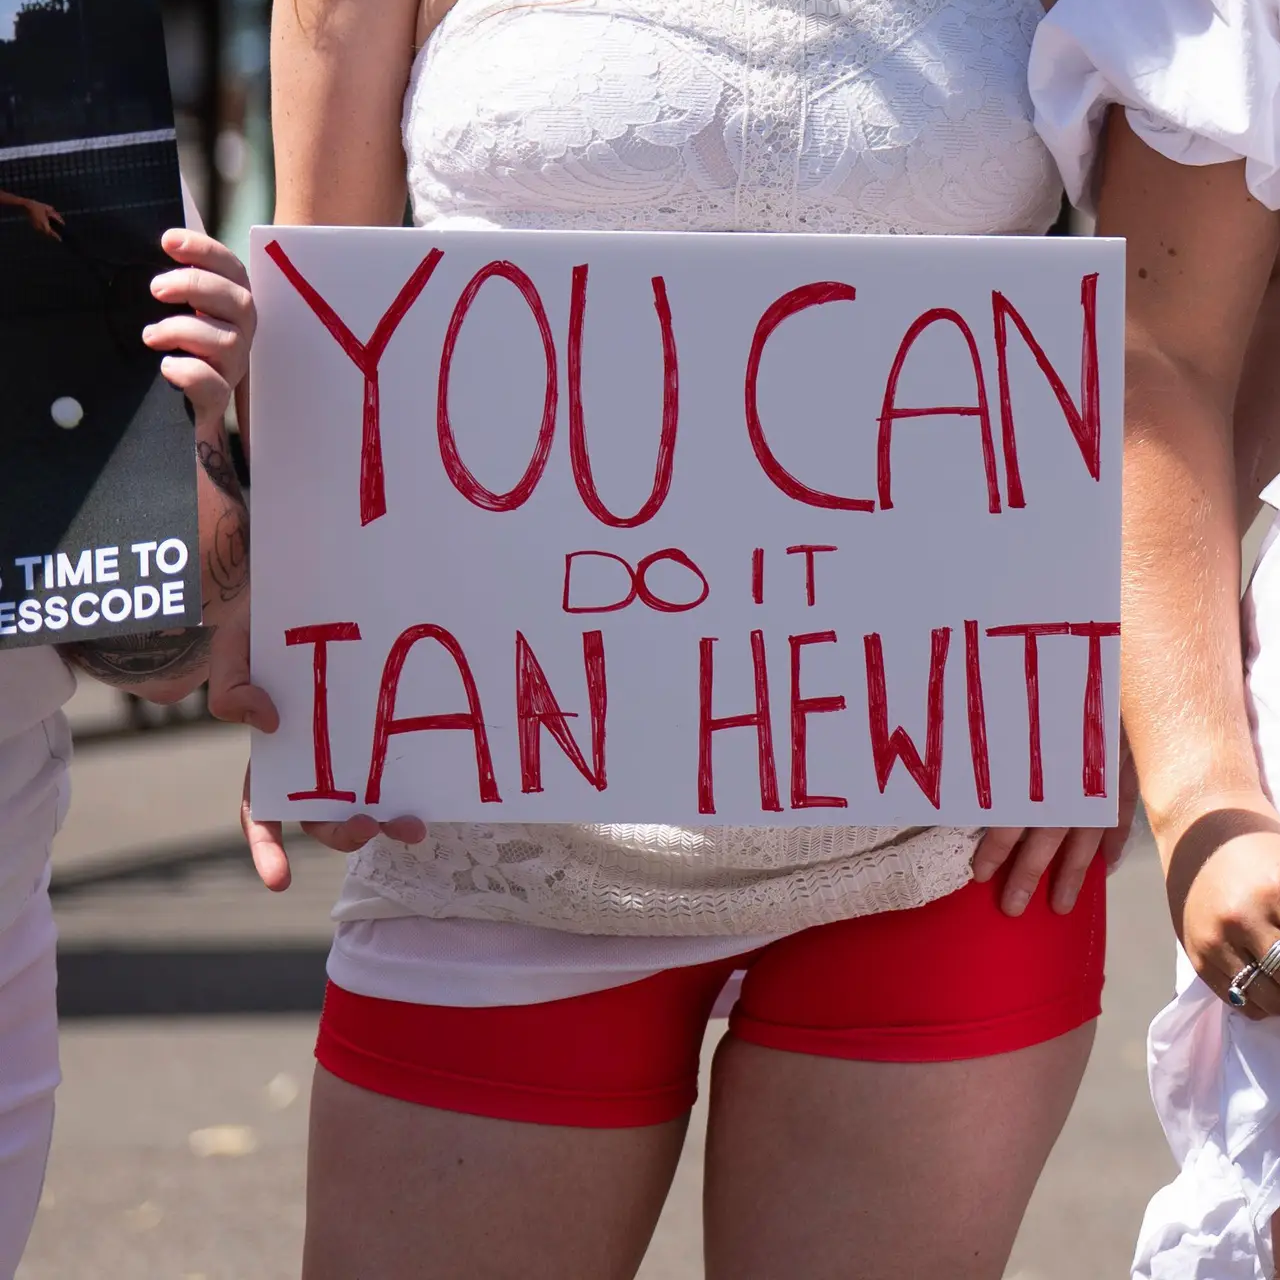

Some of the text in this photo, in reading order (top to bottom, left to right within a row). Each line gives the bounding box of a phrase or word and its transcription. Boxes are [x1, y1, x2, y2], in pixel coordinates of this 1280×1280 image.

[264, 239, 1101, 528] YOU CAN
[14, 537, 189, 591] TIME TO
[563, 545, 838, 613] DO IT
[285, 620, 1122, 814] IAN HEWITT
